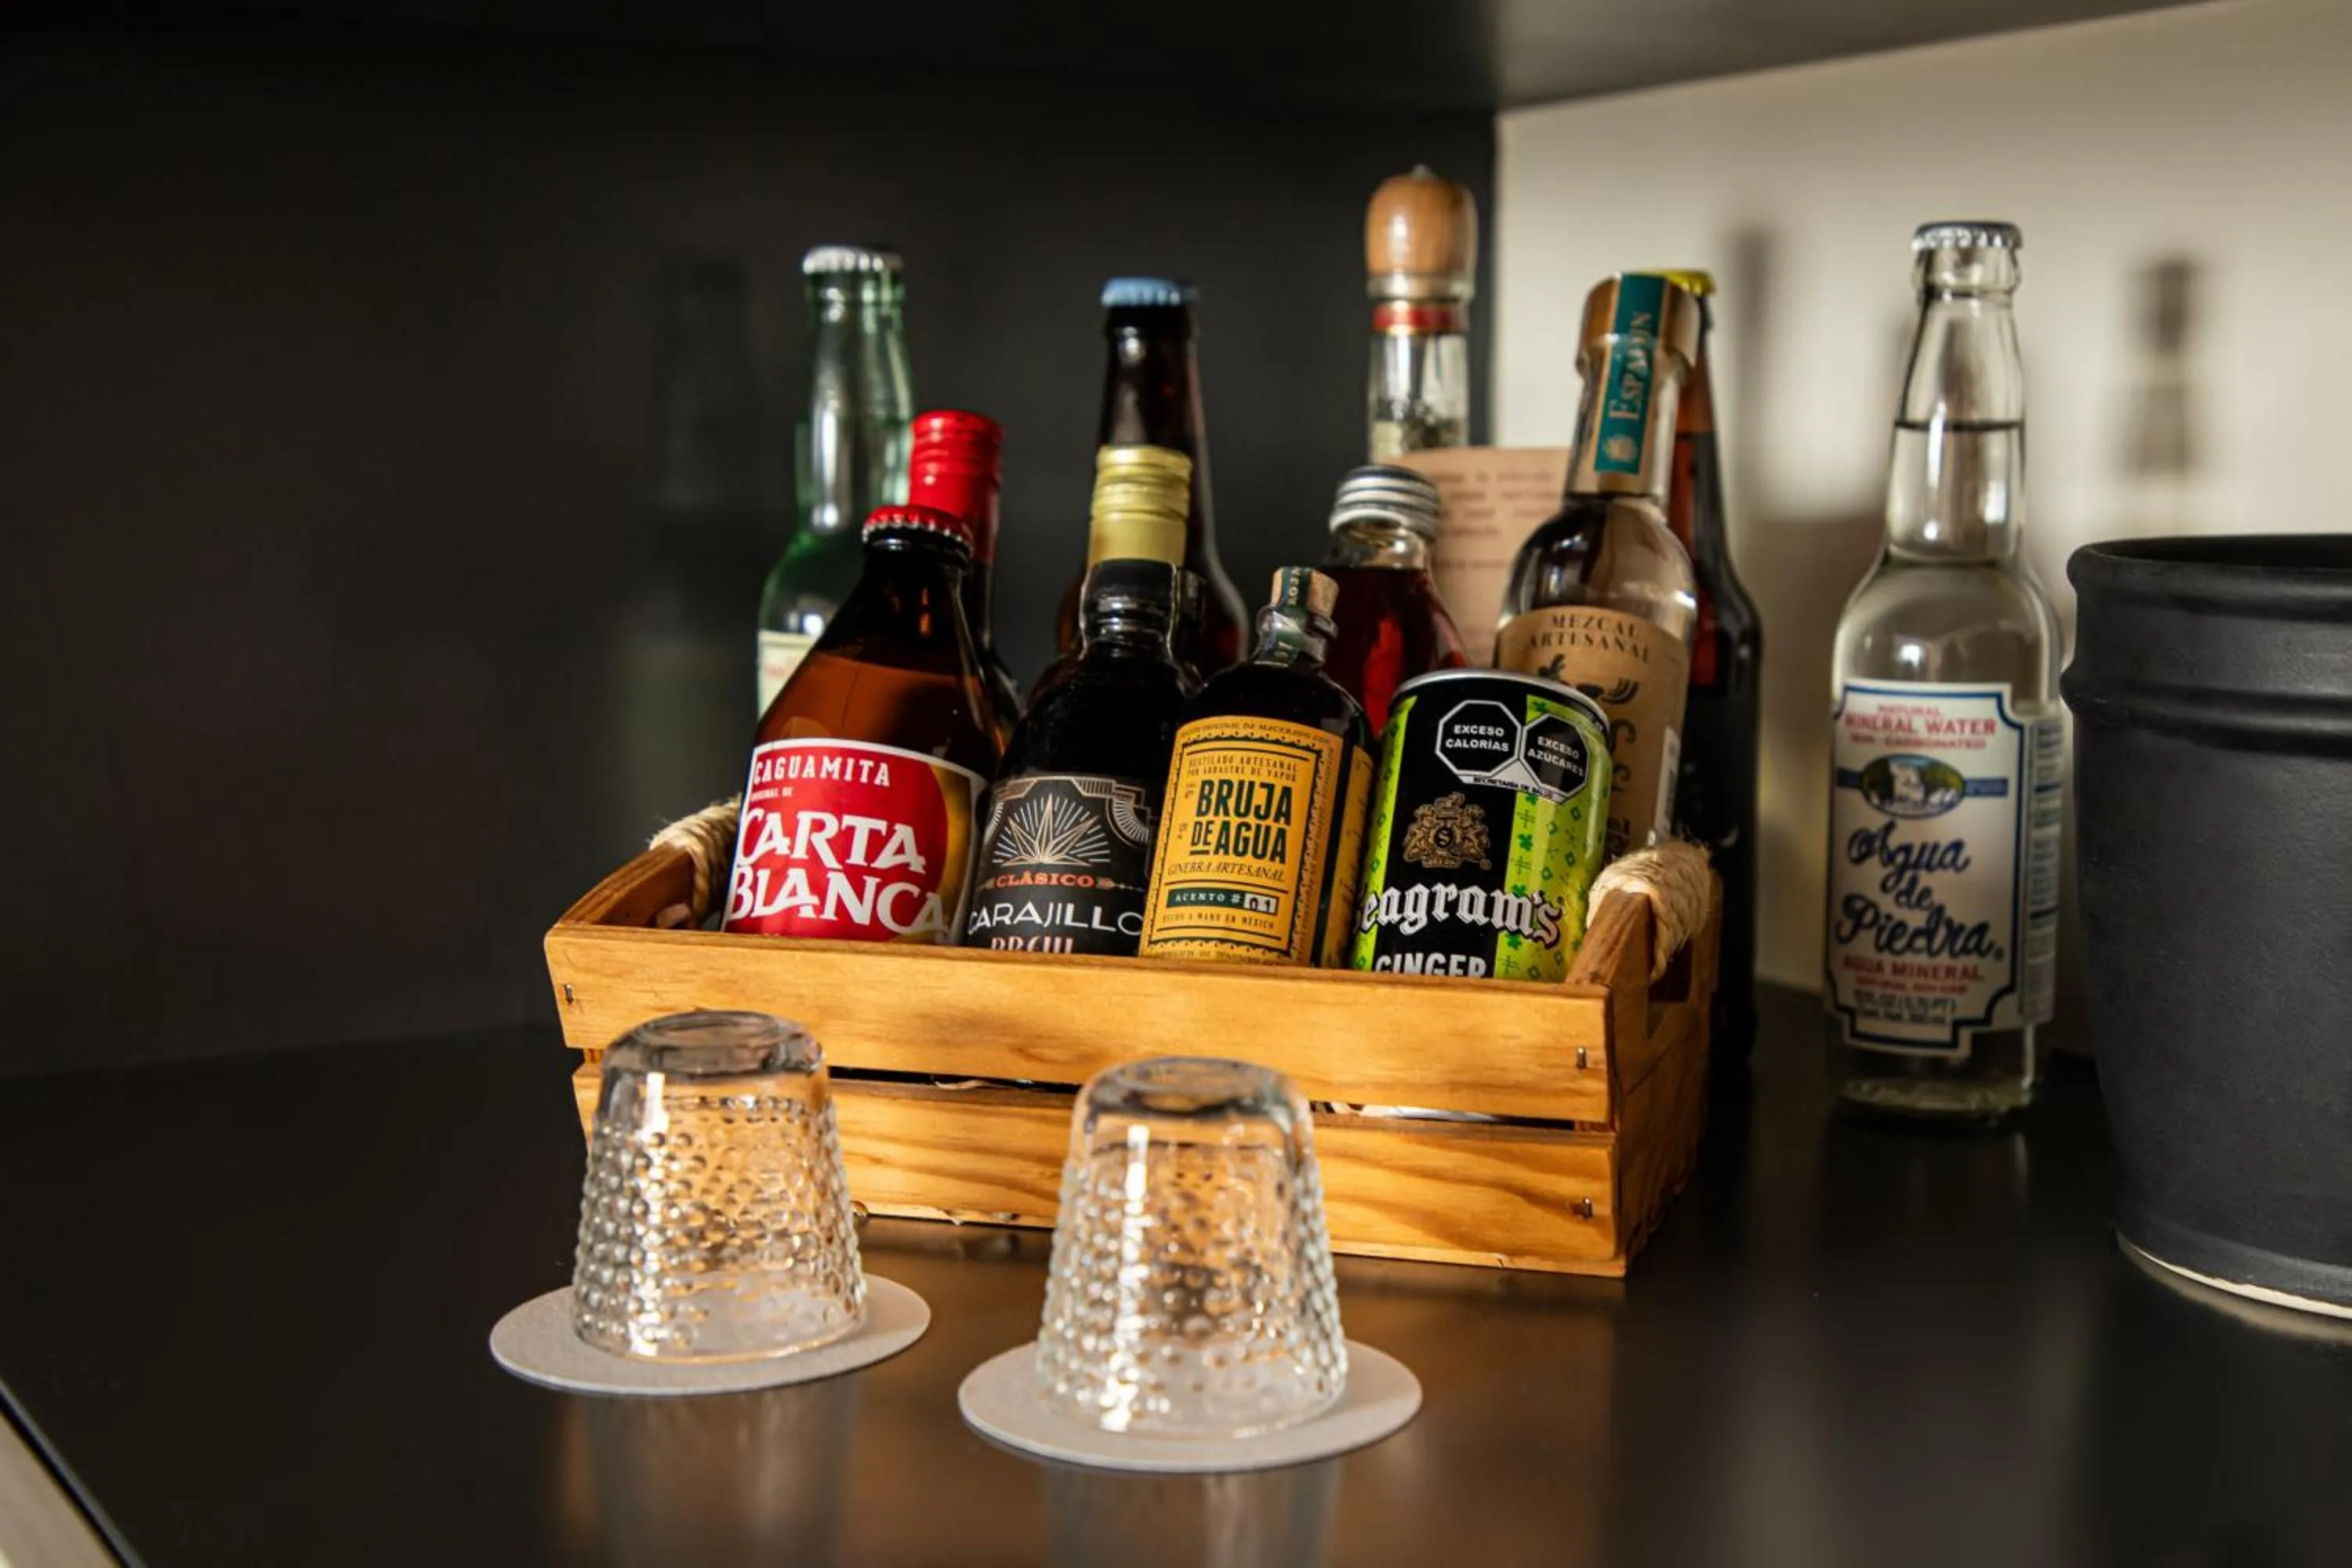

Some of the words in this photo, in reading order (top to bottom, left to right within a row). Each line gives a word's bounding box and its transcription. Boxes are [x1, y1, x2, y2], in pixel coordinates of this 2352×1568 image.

[1552, 614, 1638, 637] MEZCAL
[1530, 631, 1650, 662] ARTESANAL
[1453, 724, 1504, 737] EXCESO
[1845, 712, 1913, 733] MINERAL
[1926, 717, 1998, 735] WATER
[1445, 737, 1509, 753] CALORÍAS
[1537, 735, 1580, 759] EXCESO
[753, 755, 891, 787] CAGUAMITA
[1526, 747, 1584, 778] AZÚCARES
[1195, 778, 1292, 826] BRUJA
[739, 808, 927, 875] CARTA
[1190, 820, 1215, 847] DE
[1213, 820, 1287, 864] AGUA
[1847, 819, 1971, 893] Agua
[995, 871, 1095, 888] CLÁSICO
[1213, 862, 1286, 882] ARTESANAL
[728, 863, 953, 942] BLANCA
[1175, 892, 1225, 902] ACENTO
[1894, 872, 1934, 910] de
[967, 901, 1144, 935] CARAJILLO
[1835, 891, 1996, 960] Piedra
[1890, 961, 1985, 983] MINERAL
